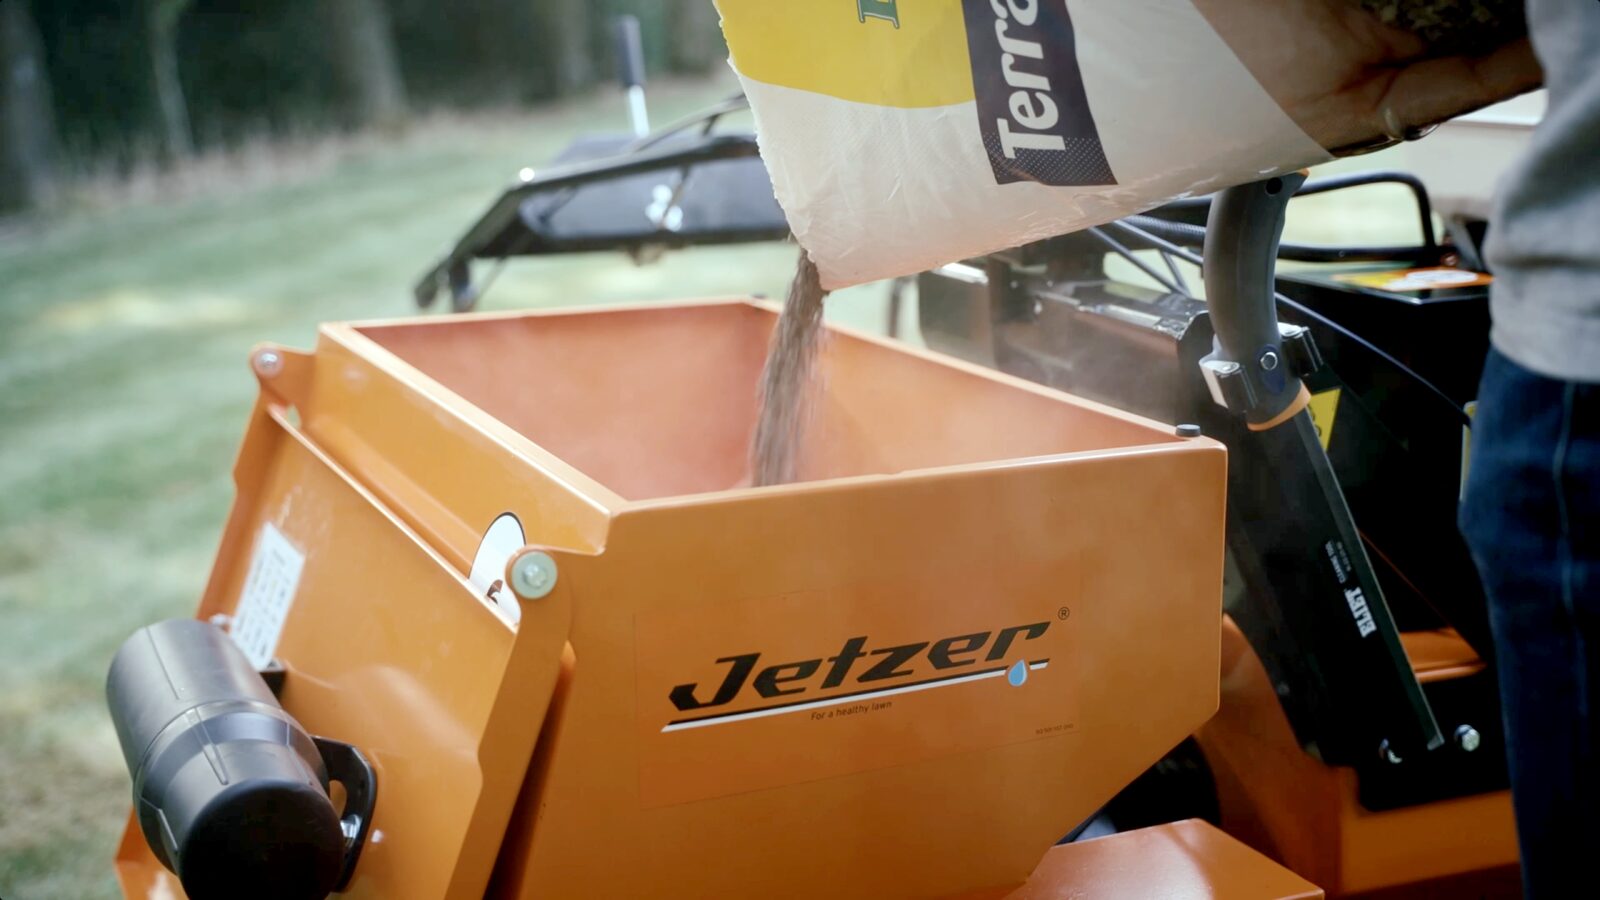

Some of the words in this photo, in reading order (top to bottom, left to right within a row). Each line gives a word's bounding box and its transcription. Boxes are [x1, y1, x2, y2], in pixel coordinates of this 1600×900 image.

[668, 621, 1051, 711] Jetzer
[811, 711, 826, 720] For
[836, 705, 869, 717] healthy
[872, 701, 892, 711] lawn
